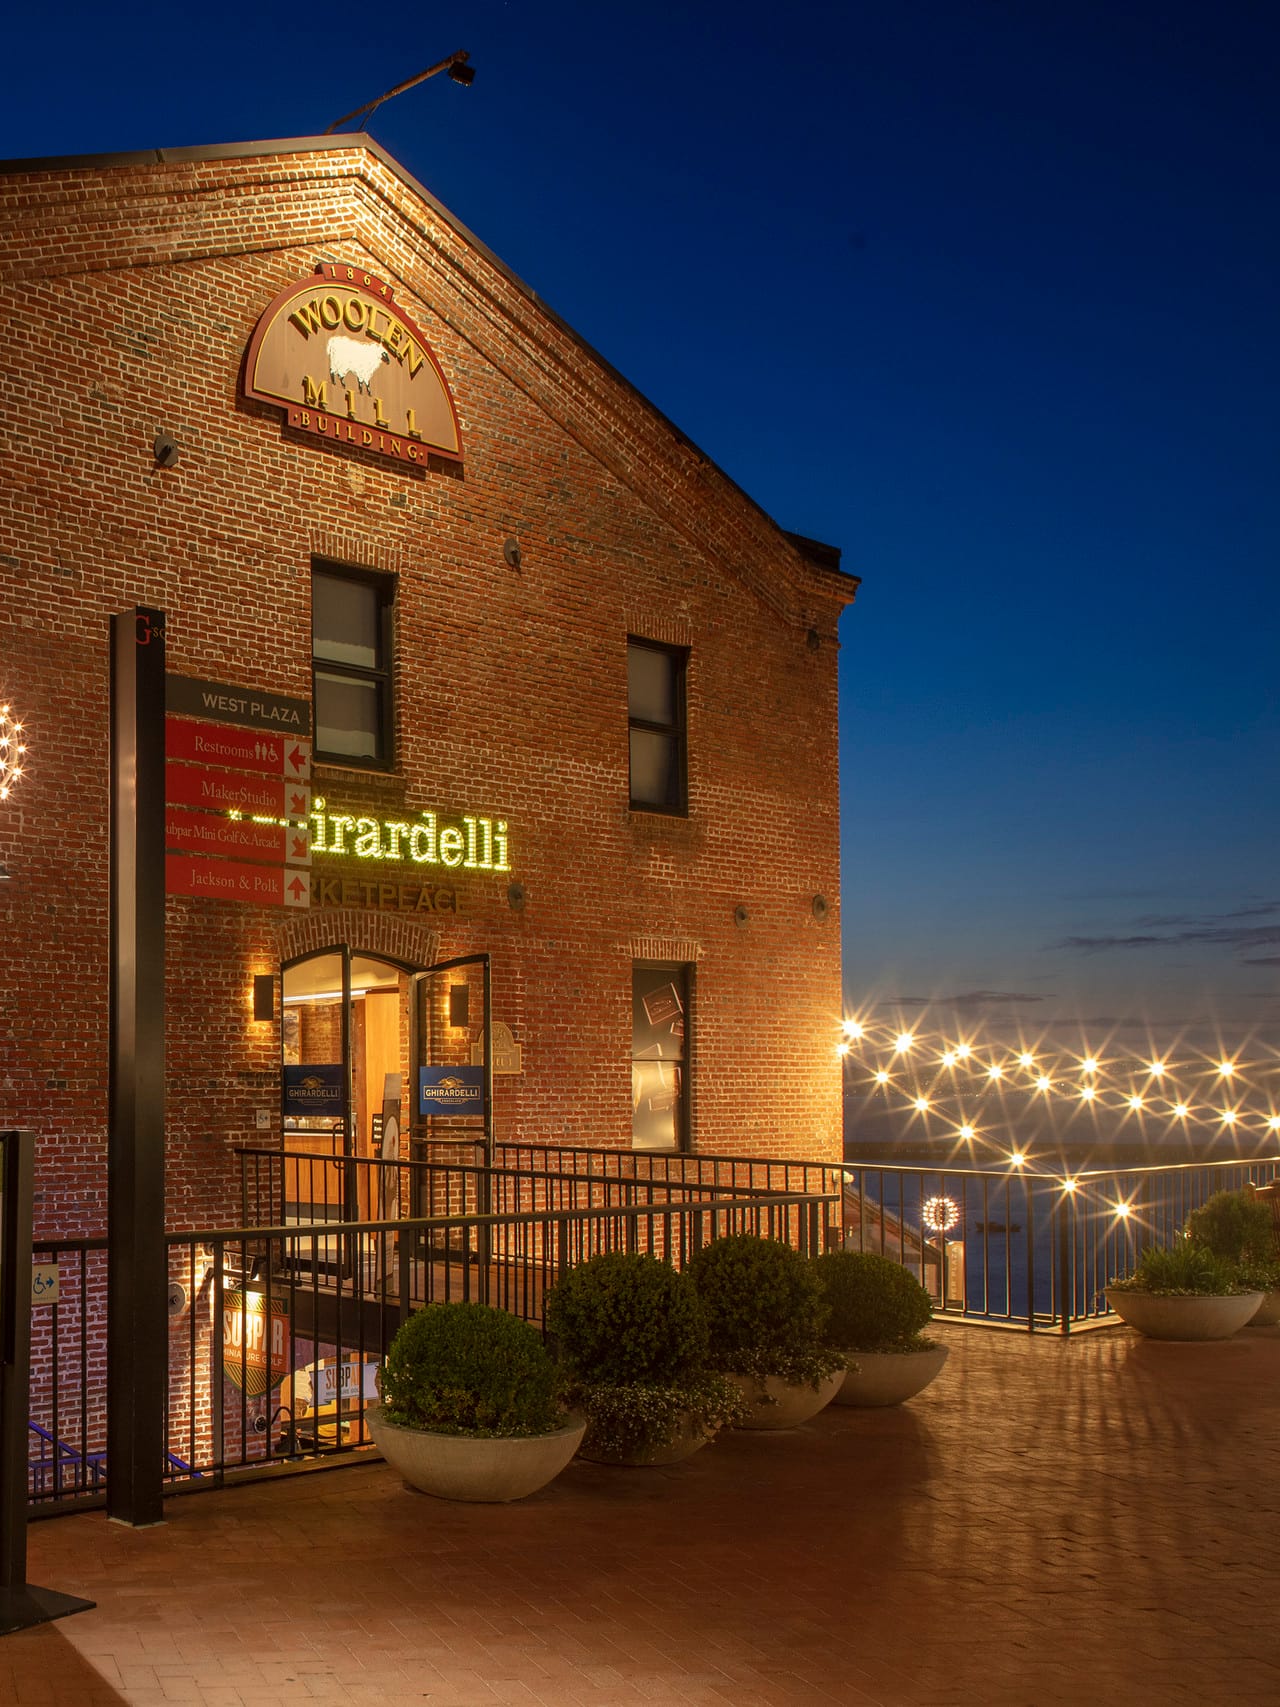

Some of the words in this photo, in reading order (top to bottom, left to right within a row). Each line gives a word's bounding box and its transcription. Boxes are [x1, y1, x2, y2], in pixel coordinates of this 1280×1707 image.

[330, 265, 388, 298] 1864
[291, 295, 424, 375] WOOLEN
[303, 375, 422, 436] MILL
[300, 411, 418, 460] BUILDING
[202, 692, 247, 714] WEST
[250, 702, 300, 725] PLAZA
[194, 735, 254, 759] Restrooms
[201, 780, 277, 807] MakerStudio
[166, 821, 191, 840] ubpar
[193, 825, 216, 841] Mini
[217, 828, 240, 844] Golf
[240, 829, 252, 845] &
[252, 832, 281, 849] Arcade
[310, 795, 512, 872] irardelli
[190, 868, 235, 888] Jackson
[238, 875, 250, 889] &
[254, 877, 279, 893] Polk
[288, 1089, 338, 1097] GHIRARDELLI
[425, 1089, 478, 1097] GHIRARDELLI
[261, 1355, 284, 1367] GLF
[325, 1364, 360, 1390] SUBPA
